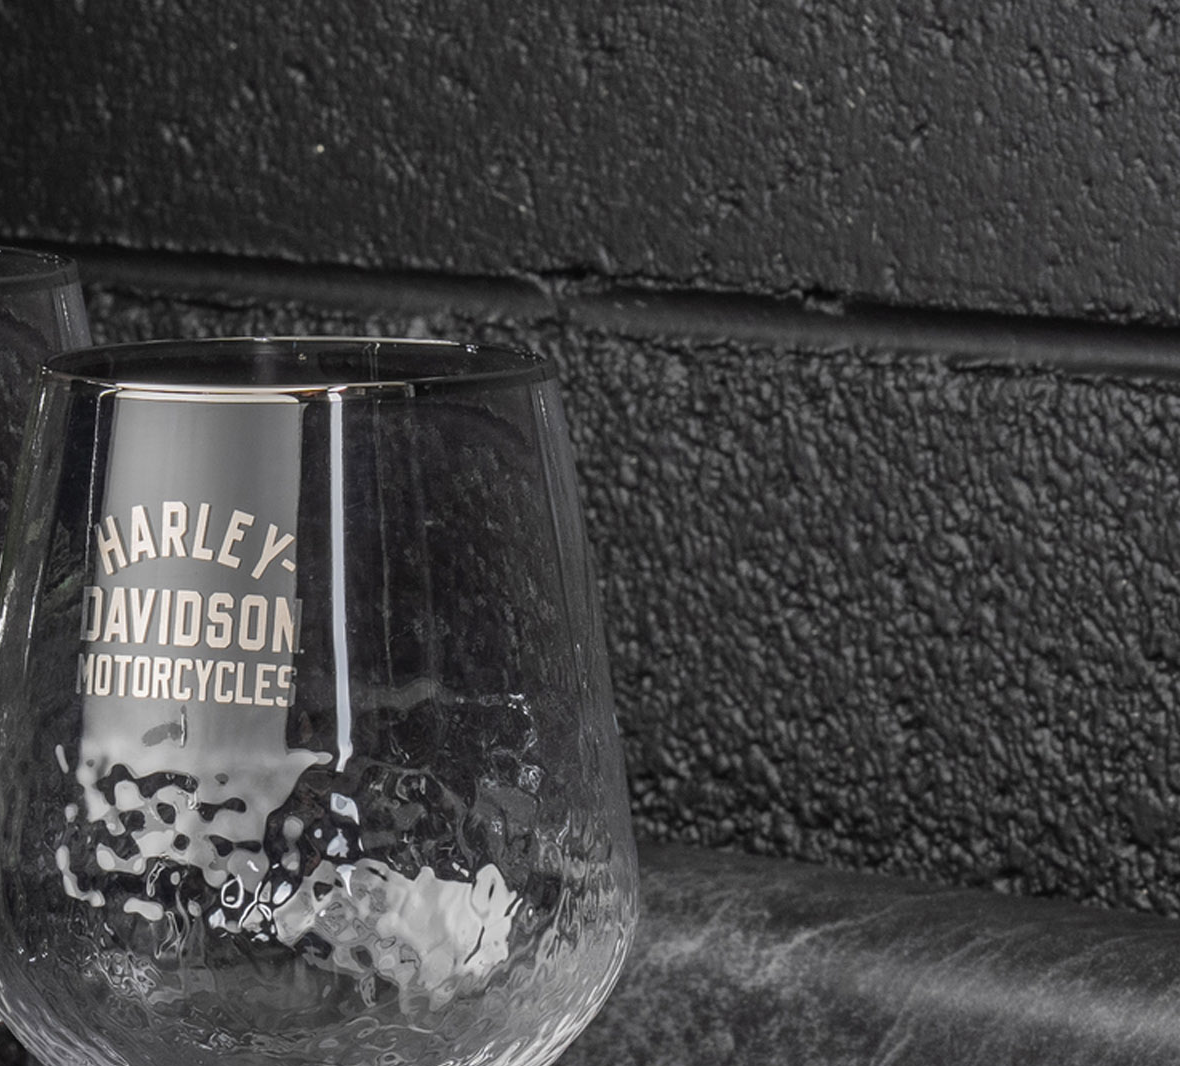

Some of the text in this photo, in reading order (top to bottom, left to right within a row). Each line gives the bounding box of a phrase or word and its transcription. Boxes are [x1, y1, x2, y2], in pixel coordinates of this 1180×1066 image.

[94, 501, 296, 580] HARLEY-
[80, 586, 303, 653] DAVIDSON
[76, 653, 297, 707] MOTORCYCLES
